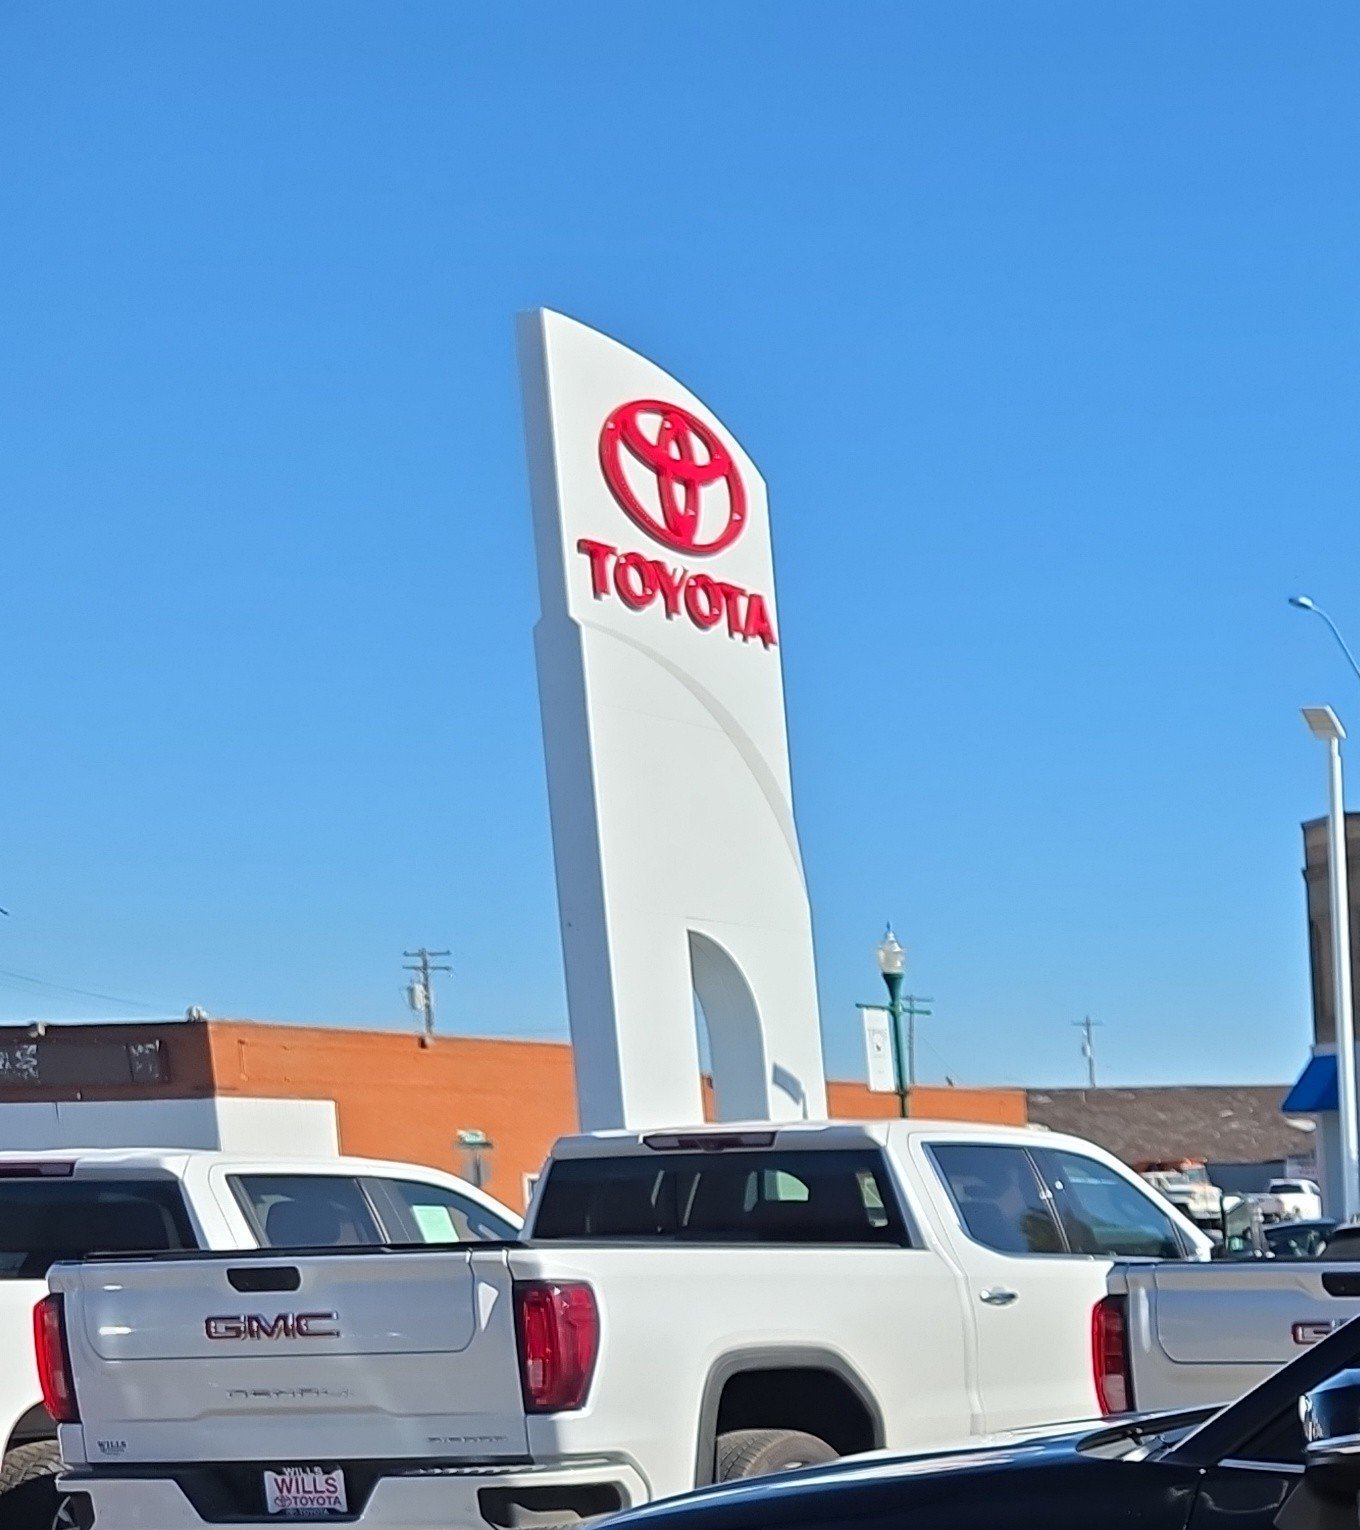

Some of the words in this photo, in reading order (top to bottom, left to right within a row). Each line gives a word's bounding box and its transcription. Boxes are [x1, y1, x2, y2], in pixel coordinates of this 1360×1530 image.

[577, 538, 777, 651] TOYOTA
[204, 1311, 341, 1340] GMC
[274, 1476, 338, 1494] WILLS
[292, 1495, 342, 1506] TOYOTA
